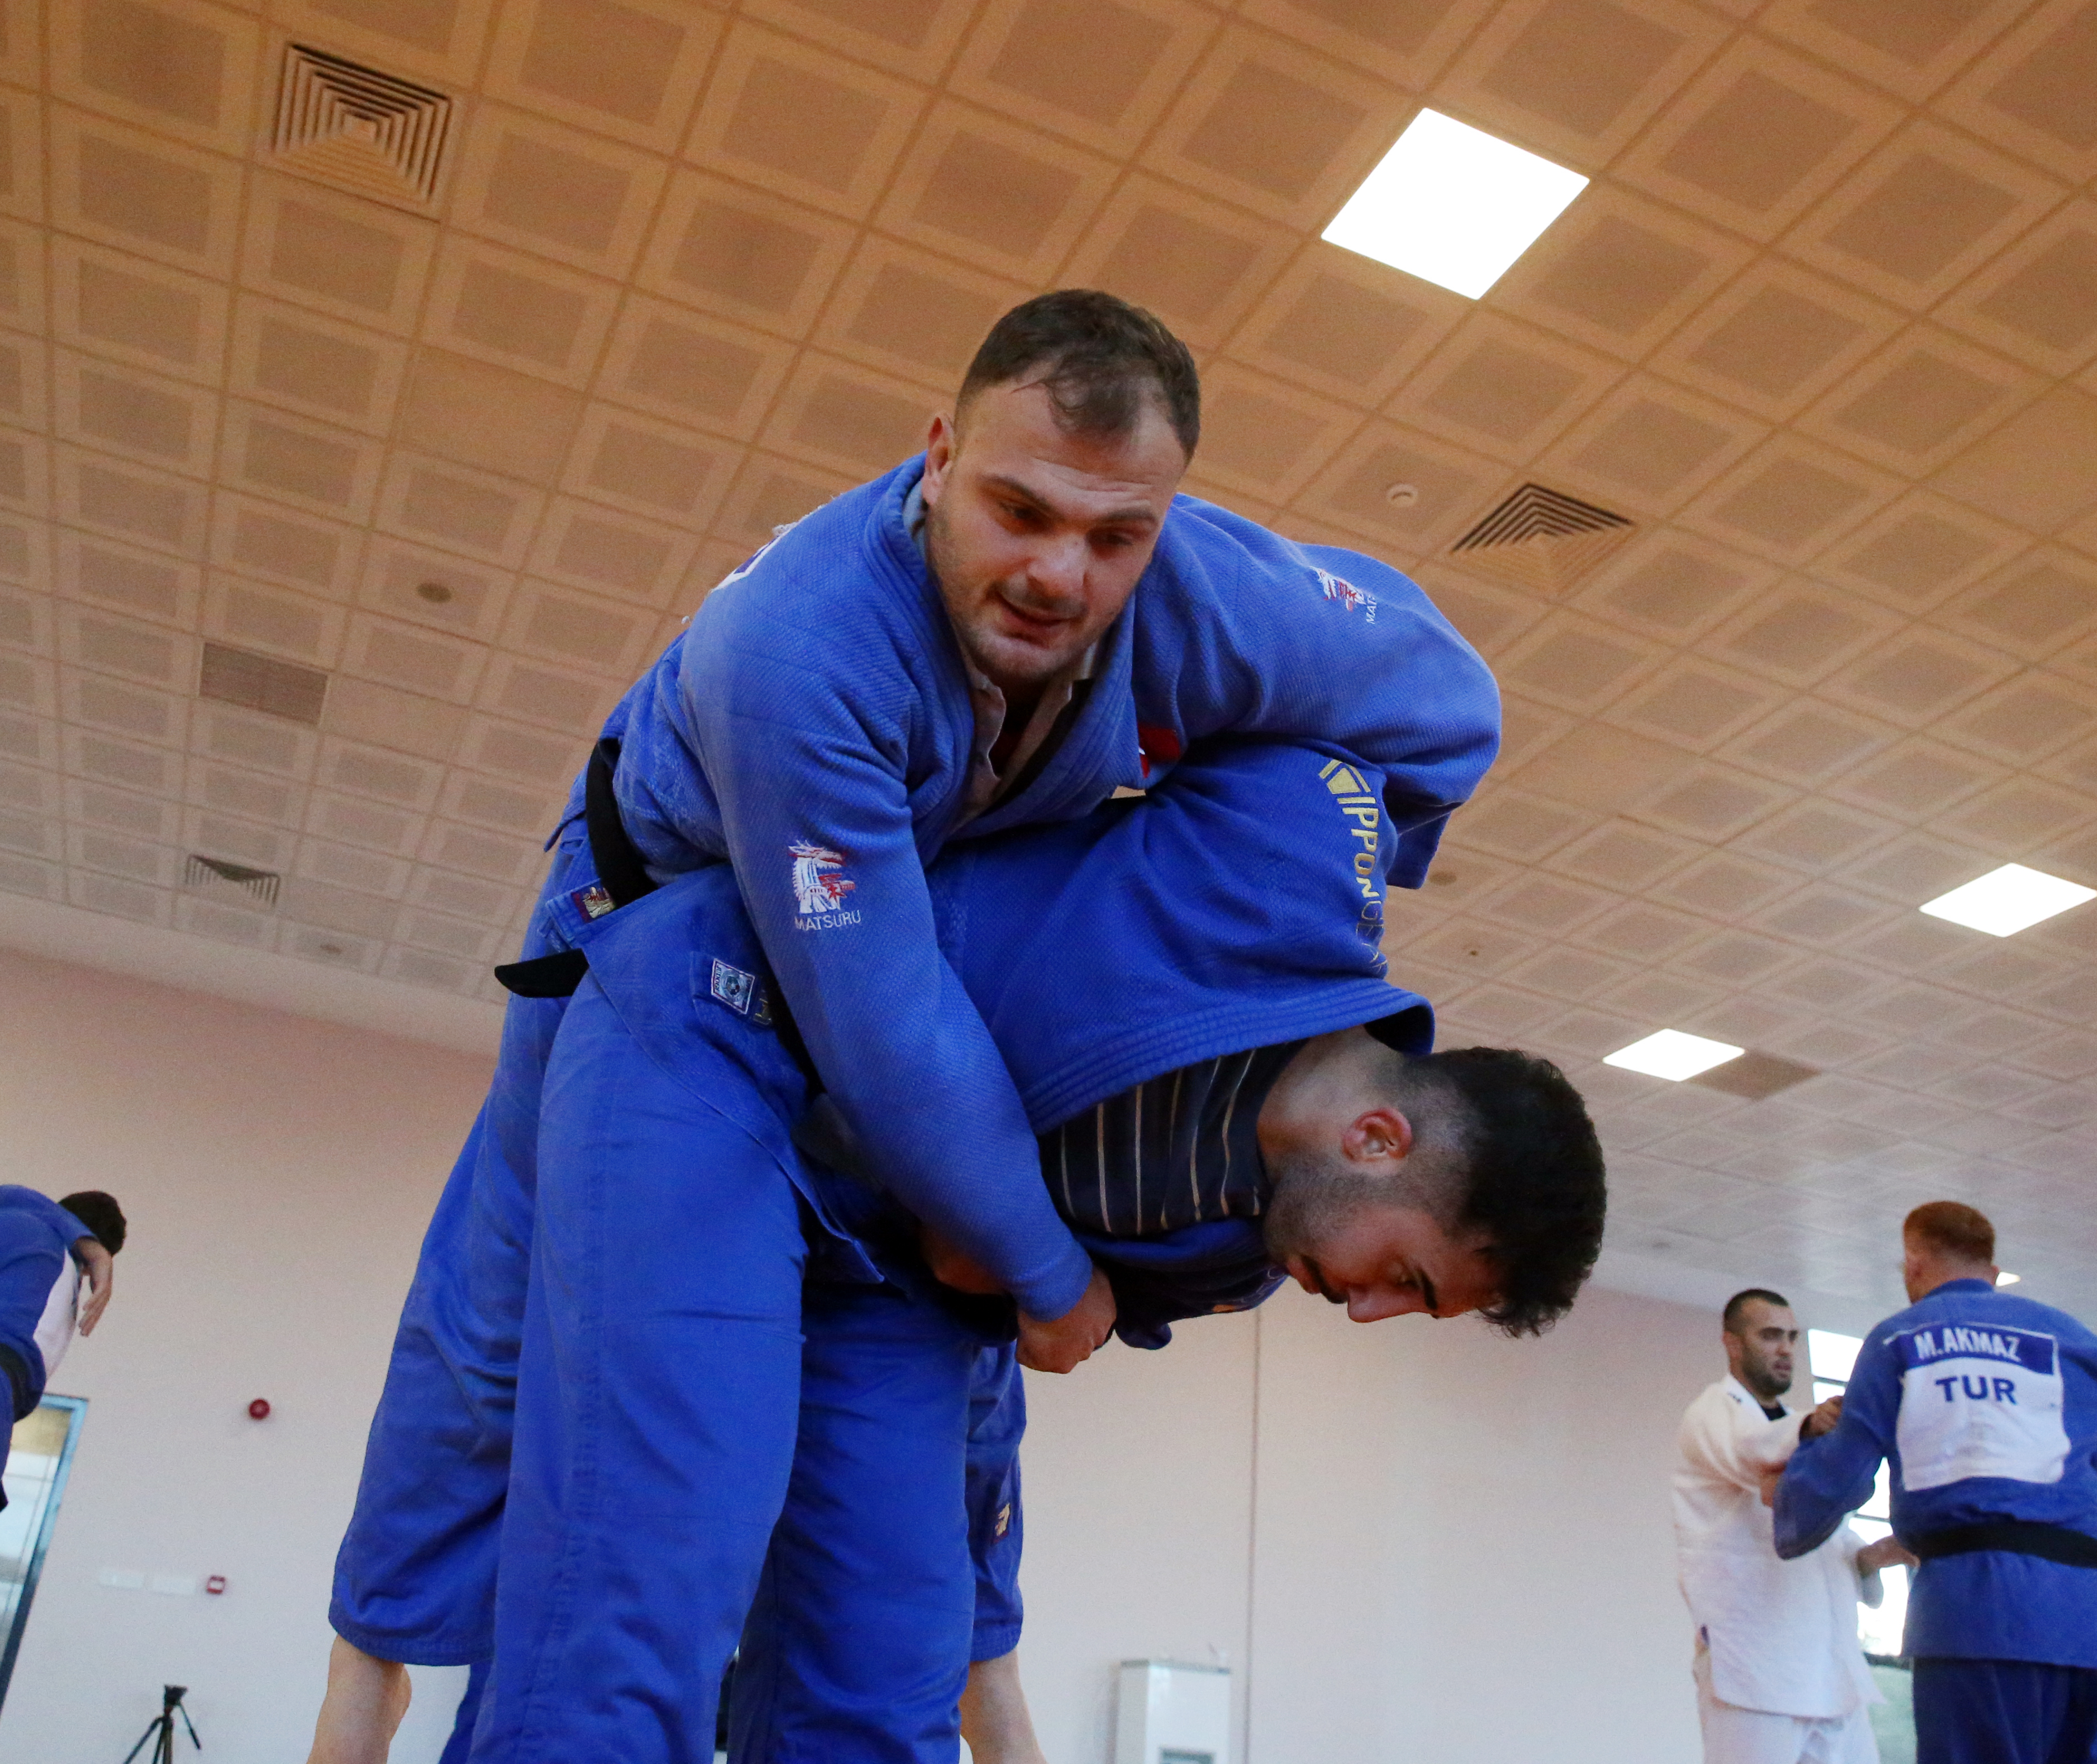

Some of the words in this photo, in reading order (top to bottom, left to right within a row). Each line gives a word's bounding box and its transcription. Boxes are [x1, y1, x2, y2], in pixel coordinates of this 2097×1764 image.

[1337, 796, 1380, 898] IPPON
[794, 909, 862, 931] MATSURU
[1914, 1327, 2022, 1362] M.AKMAZ
[1935, 1375, 2018, 1405] TUR
